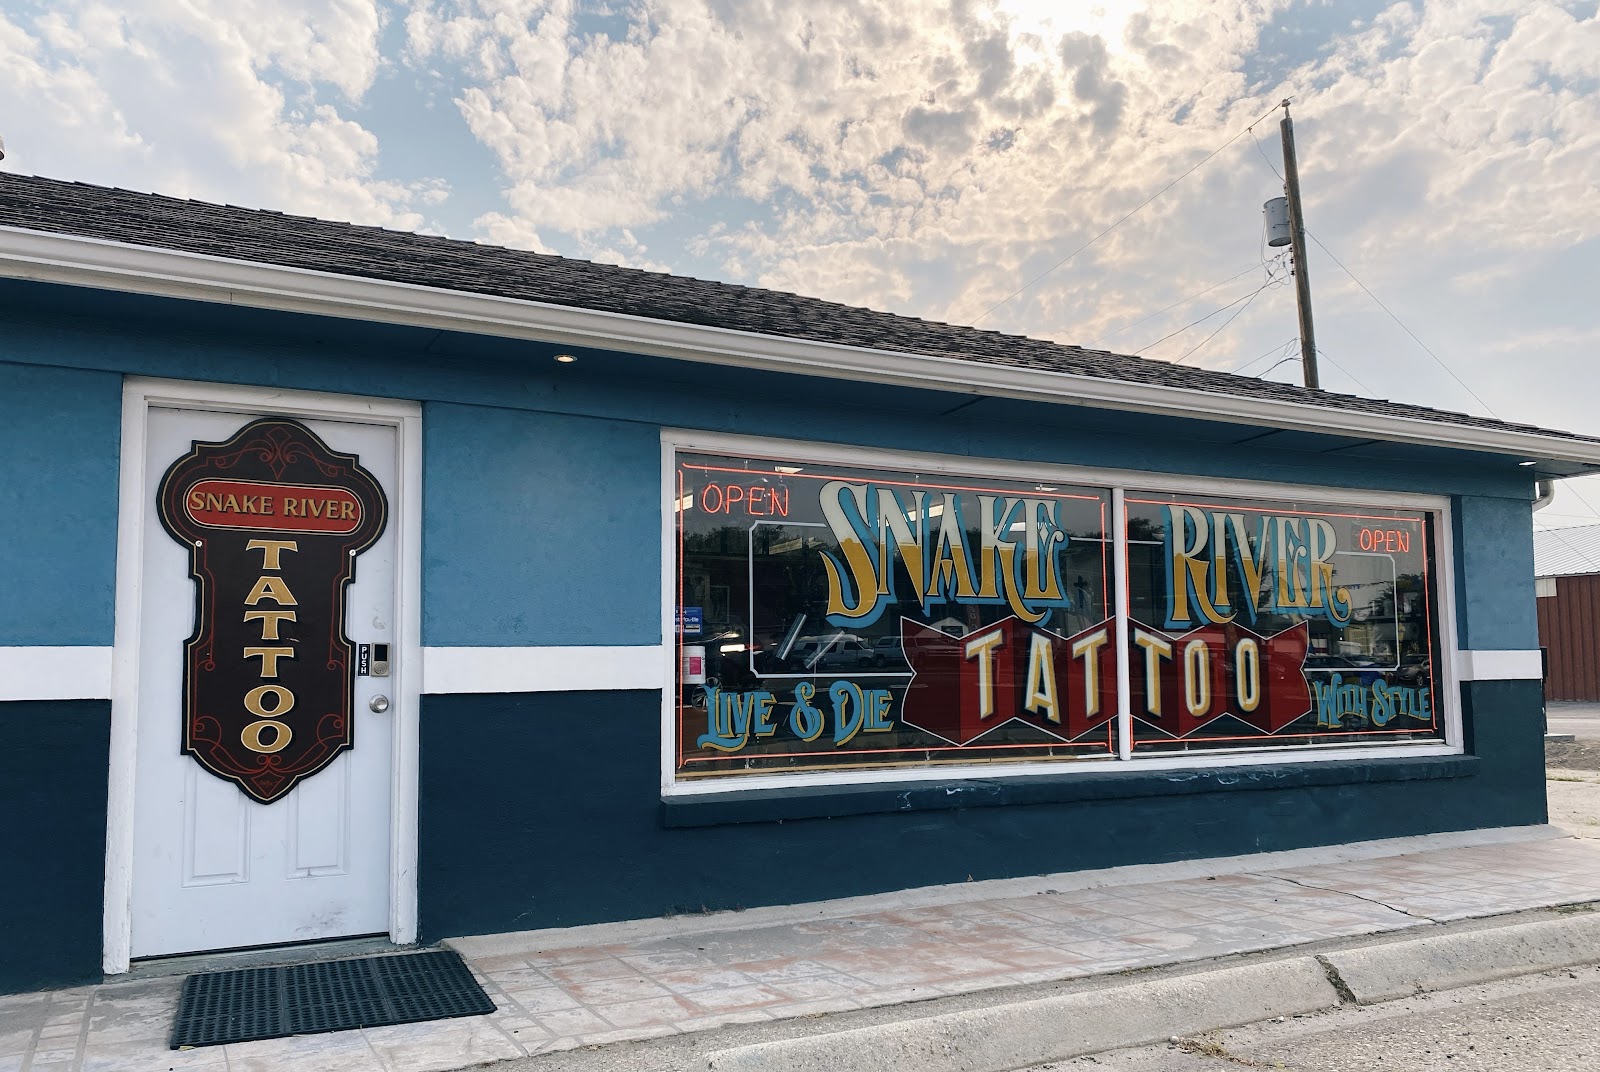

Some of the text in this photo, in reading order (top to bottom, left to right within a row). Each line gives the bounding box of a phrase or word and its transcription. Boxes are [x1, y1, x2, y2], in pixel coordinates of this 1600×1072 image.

[190, 491, 357, 521] SNAKE RIVER
[702, 484, 788, 516] OPEN
[818, 480, 1353, 629] SNAKE RIVER
[1359, 529, 1410, 552] OPEN
[241, 539, 298, 753] TATTOO
[964, 627, 1261, 725] TATTOO
[697, 681, 895, 752] LIVE & DIE
[1314, 673, 1431, 729] WITH STYLE
